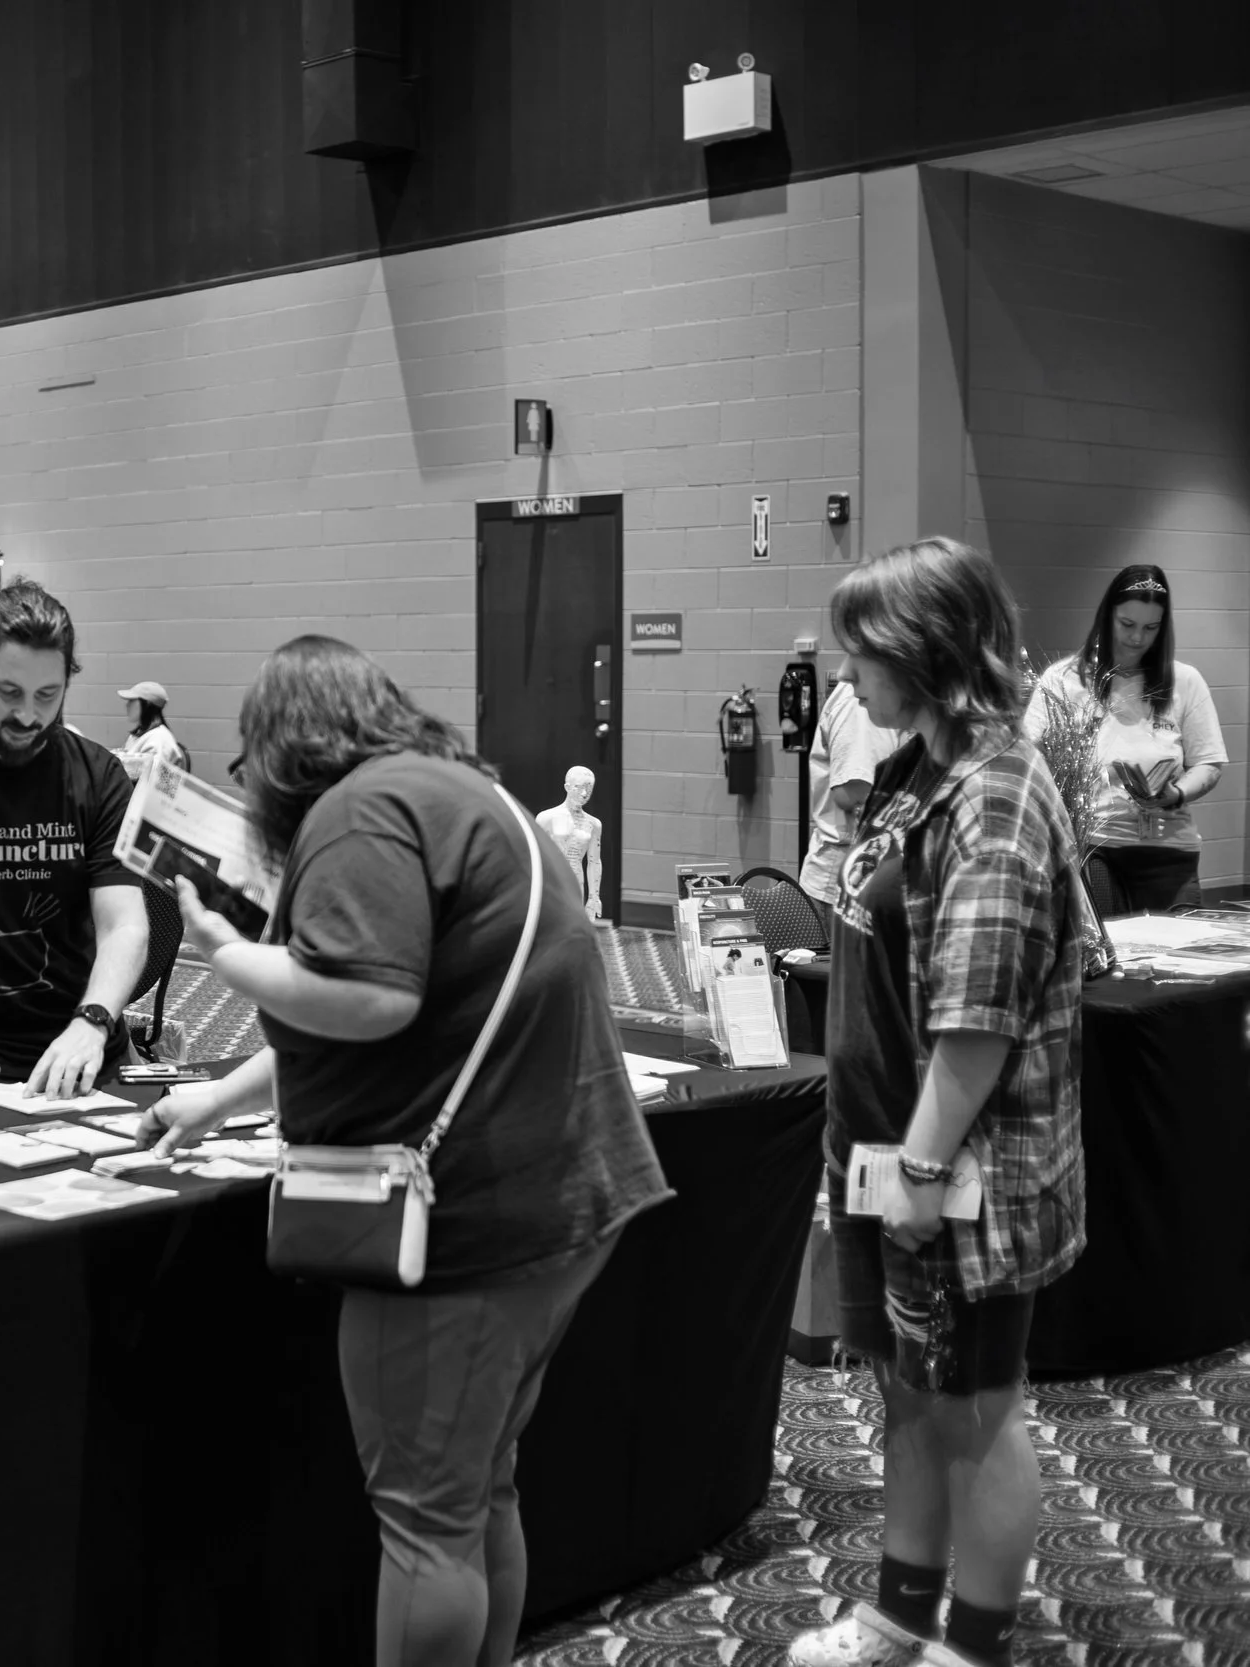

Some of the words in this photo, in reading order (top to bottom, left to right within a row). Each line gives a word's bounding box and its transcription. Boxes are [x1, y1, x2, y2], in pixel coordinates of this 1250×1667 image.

[517, 498, 574, 516] WOMEN
[635, 623, 677, 635] WOMEN
[36, 822, 76, 839] Mint
[15, 868, 52, 880] Clinic
